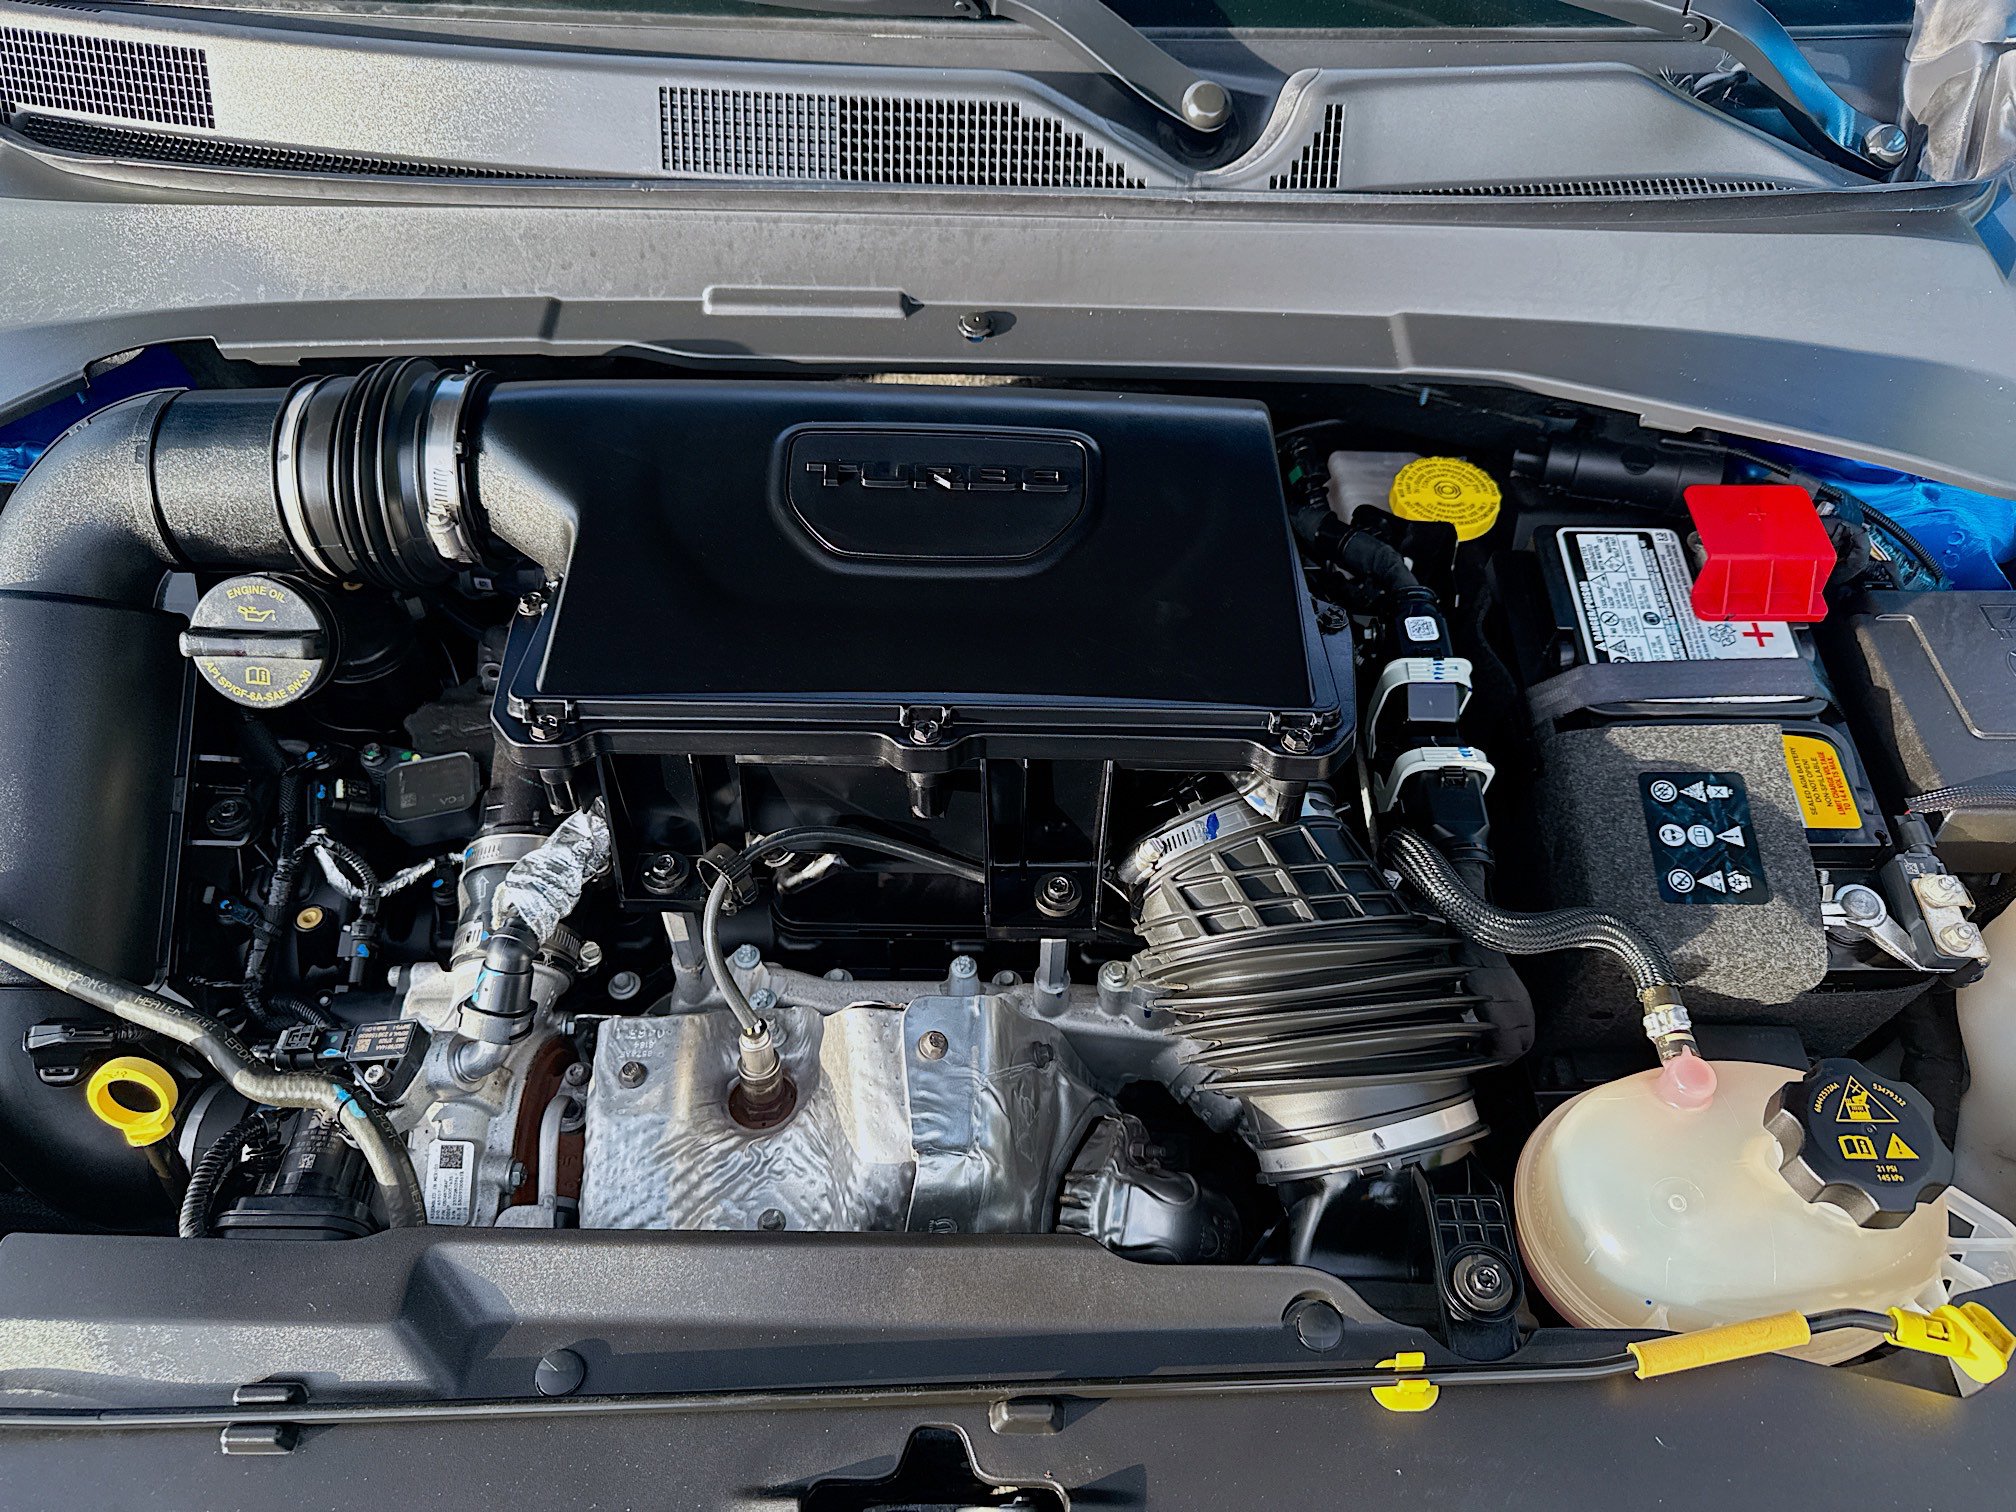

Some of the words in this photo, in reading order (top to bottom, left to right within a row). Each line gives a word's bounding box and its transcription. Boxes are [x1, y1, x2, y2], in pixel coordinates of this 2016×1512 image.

[226, 585, 266, 600] ENGINE
[268, 590, 286, 603] OIL
[1578, 580, 1603, 641] DANGER/POISON
[204, 660, 222, 679] API
[288, 669, 312, 694] 5W-30
[1790, 746, 1804, 773] BATTERY
[1816, 751, 1831, 774] VOLTAGE
[1799, 774, 1808, 788] AGM
[1808, 779, 1818, 791] NOT
[1810, 757, 1833, 806] NON-SPILLABLE
[1825, 777, 1839, 798] CHARGE
[1831, 771, 1844, 788] VOLTS
[1805, 790, 1818, 815] SEALED
[1812, 793, 1822, 802] DO
[1833, 800, 1846, 815] LIMIT
[1842, 802, 1851, 810] TO
[134, 994, 186, 1016] HEATER
